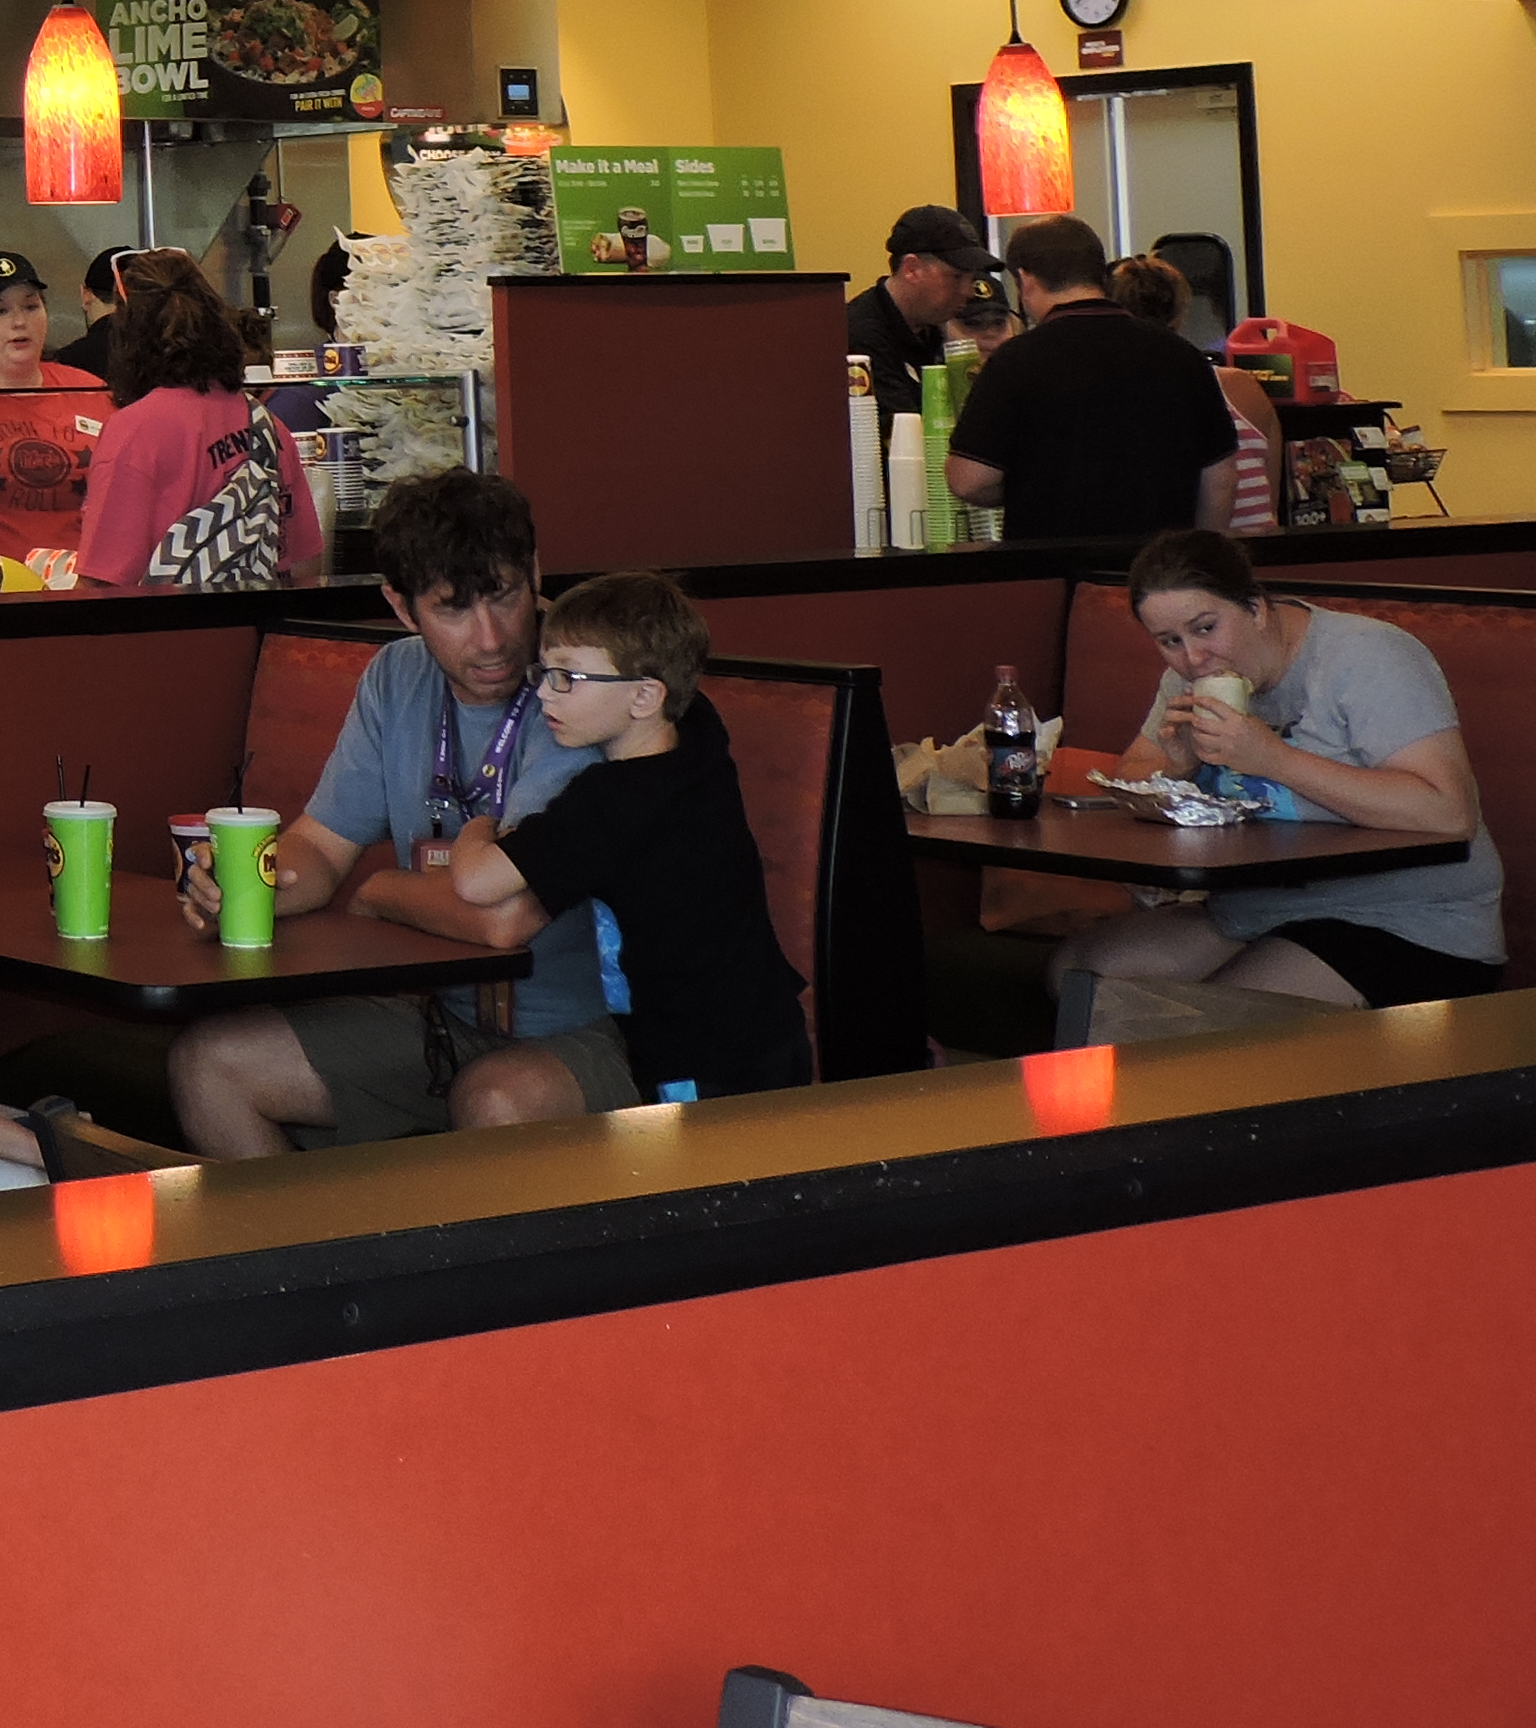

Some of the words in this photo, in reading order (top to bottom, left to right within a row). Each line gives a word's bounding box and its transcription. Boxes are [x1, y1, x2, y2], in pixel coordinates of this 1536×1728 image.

[109, 22, 208, 65] LIME
[116, 61, 209, 95] BOWL
[555, 159, 595, 174] Make
[597, 159, 610, 174] it
[612, 162, 622, 174] a
[624, 159, 659, 174] Meal
[675, 159, 715, 174] Sides
[494, 718, 515, 754] WELCOME
